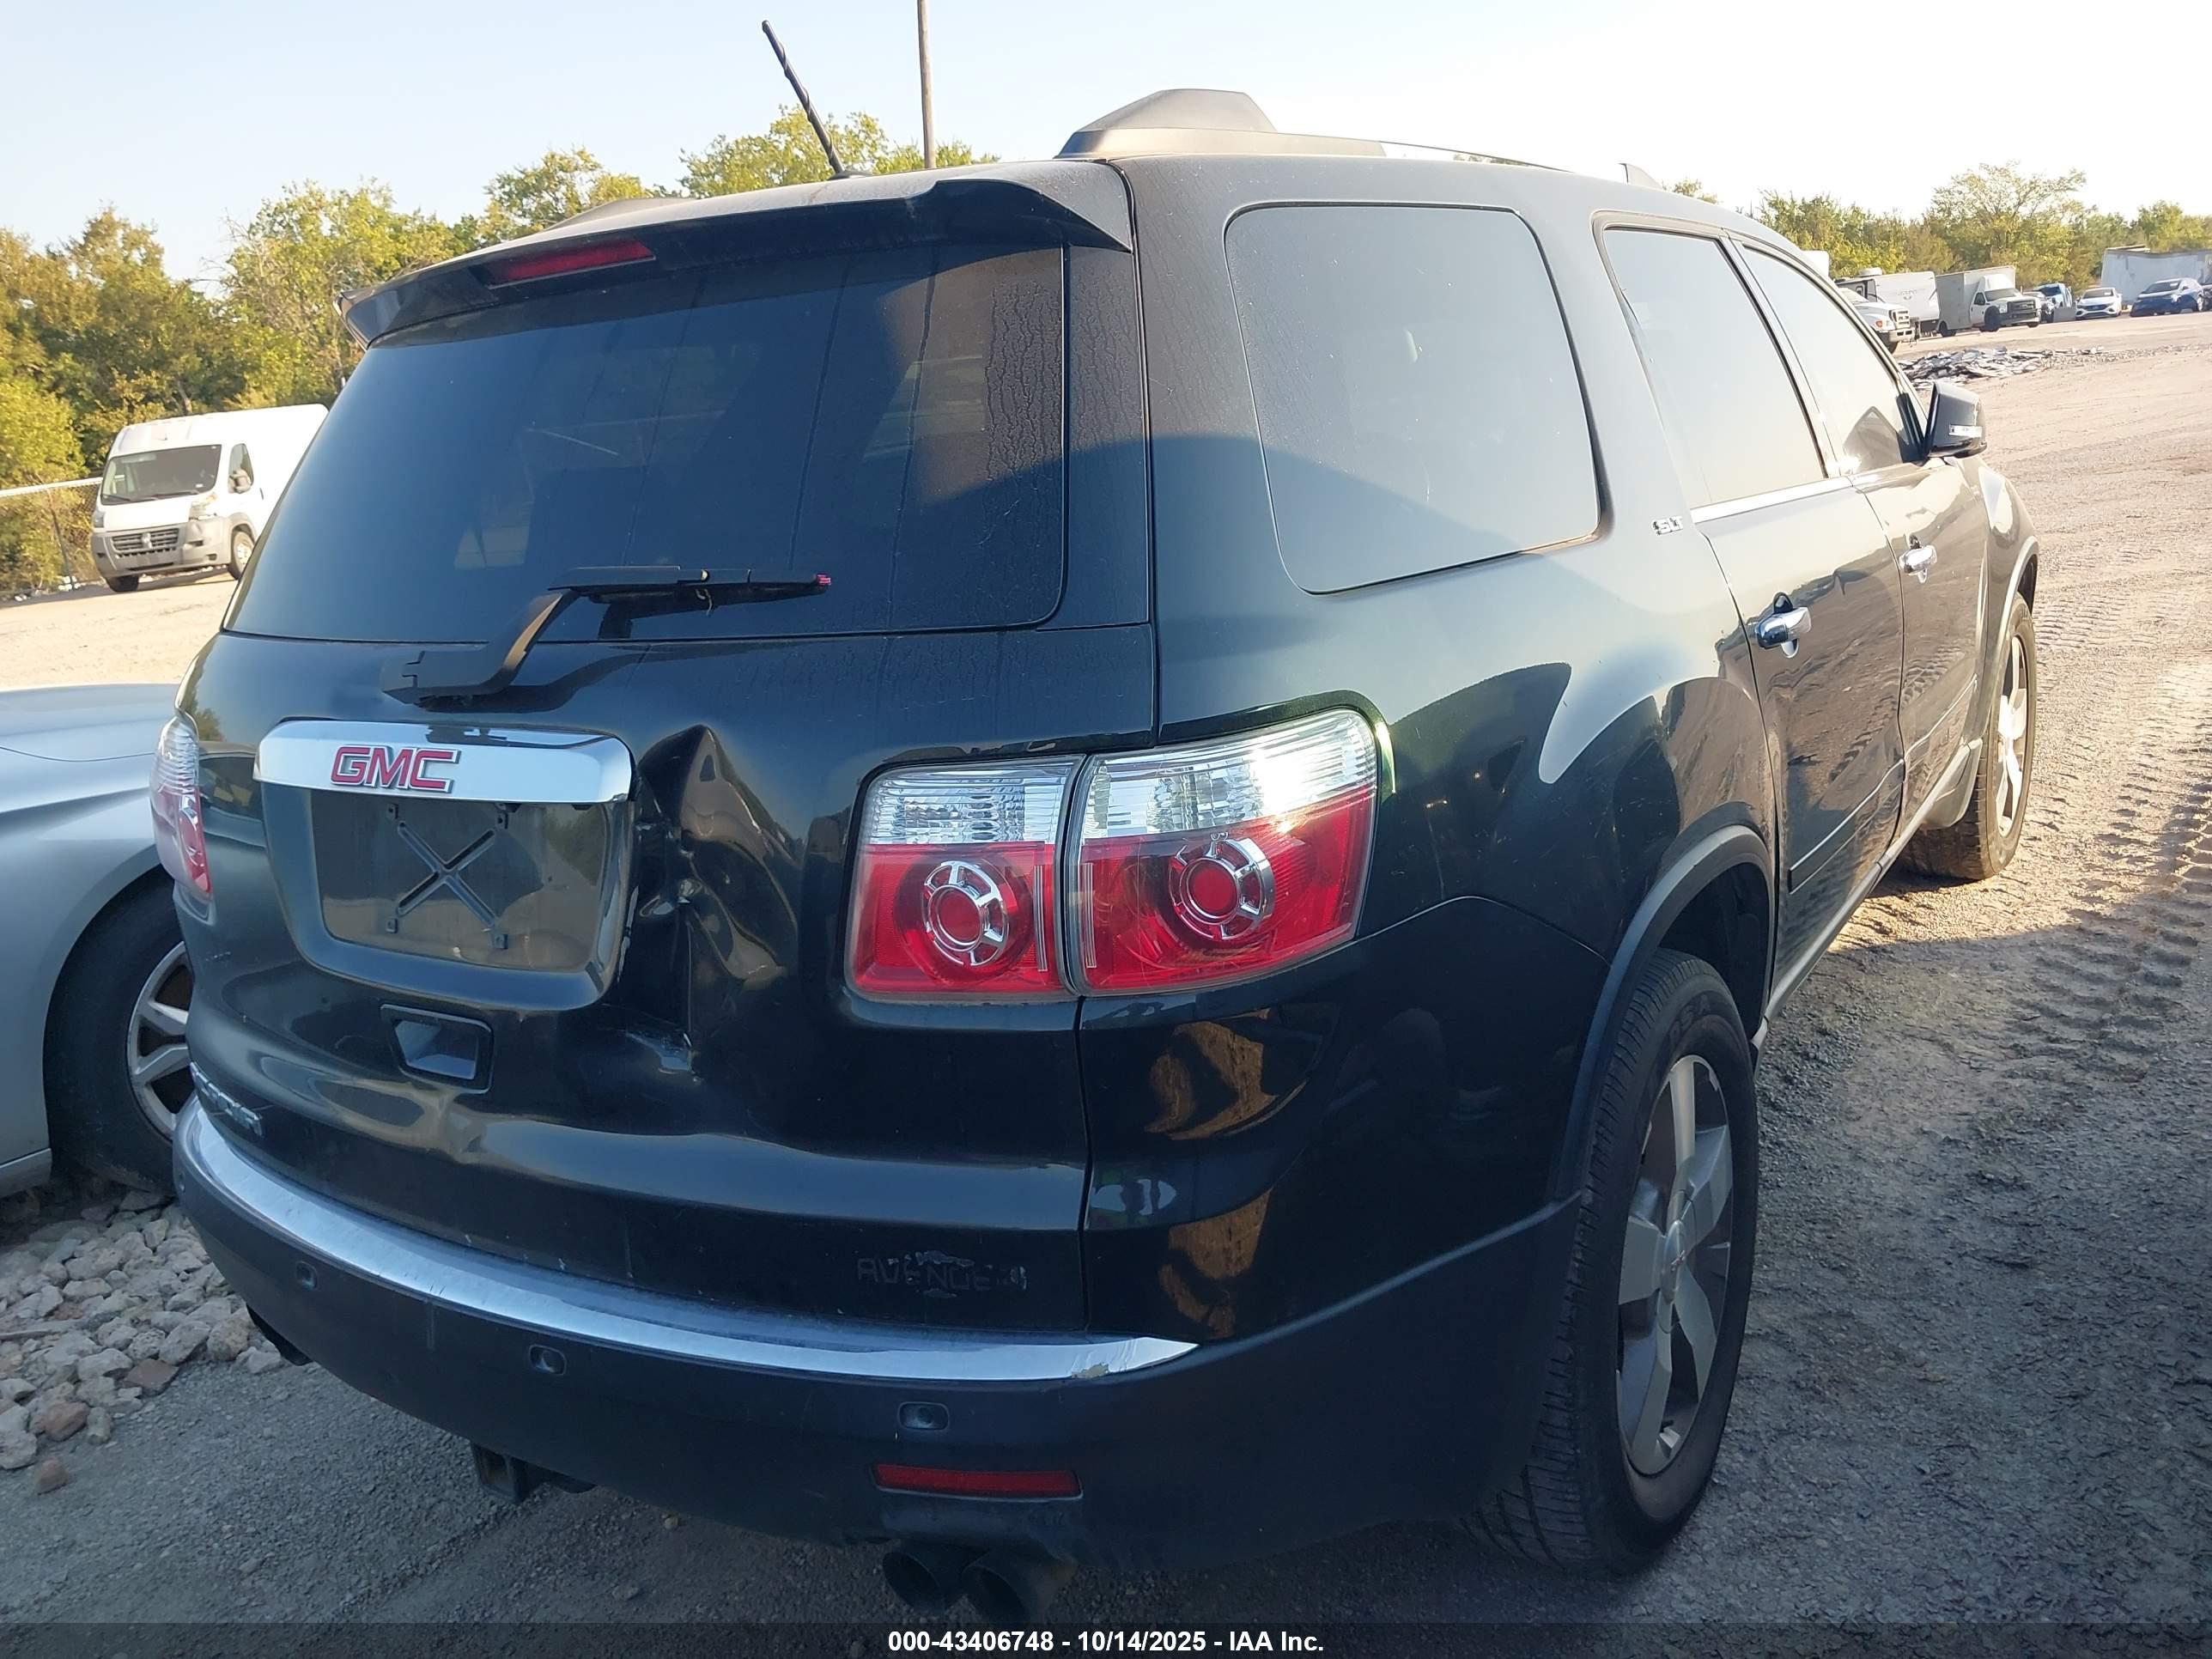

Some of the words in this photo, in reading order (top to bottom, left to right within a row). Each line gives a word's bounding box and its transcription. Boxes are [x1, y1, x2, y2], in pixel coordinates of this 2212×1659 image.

[1651, 515, 1684, 536] SLT
[331, 744, 461, 793] GMC
[857, 1257, 991, 1291] AVENUE
